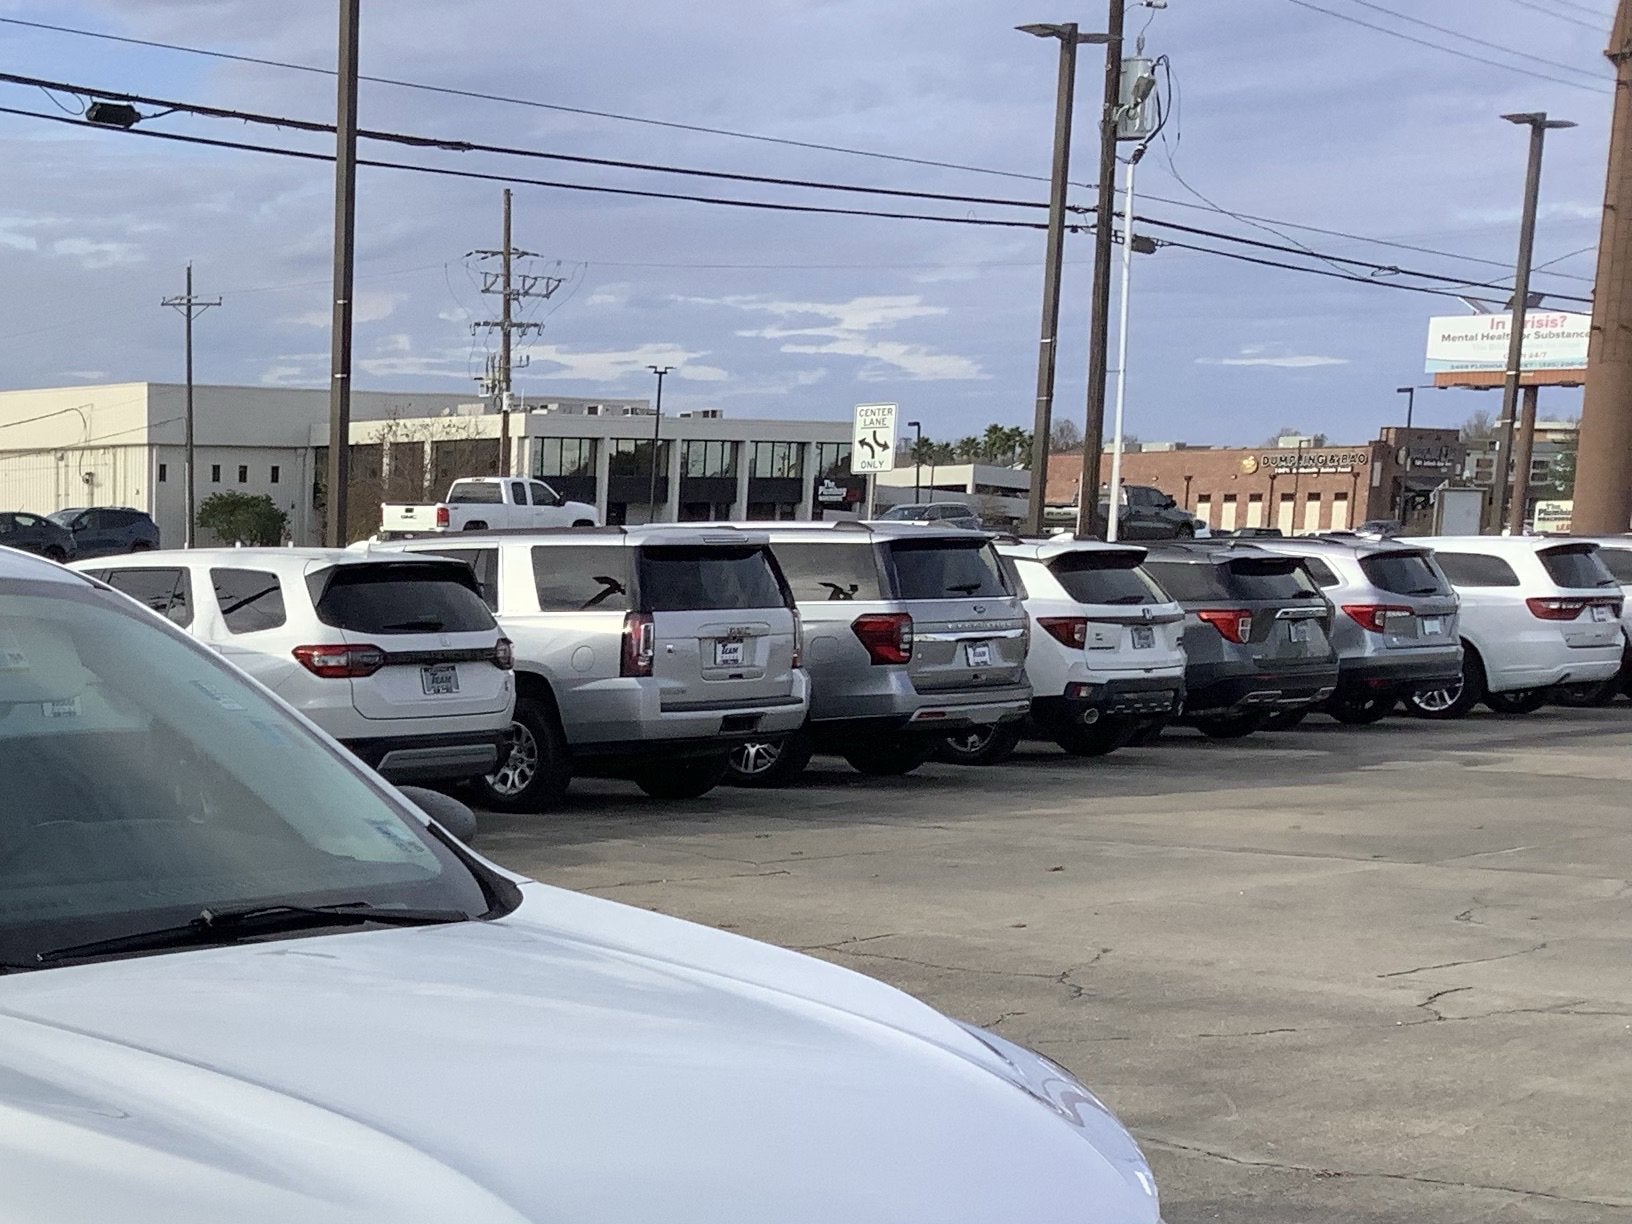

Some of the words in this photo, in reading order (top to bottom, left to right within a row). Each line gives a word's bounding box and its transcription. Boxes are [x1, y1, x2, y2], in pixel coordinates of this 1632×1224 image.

[1490, 318, 1505, 330] In
[1524, 315, 1567, 329] risis?
[1441, 333, 1478, 342] Mental
[1481, 332, 1511, 341] Healt
[858, 407, 894, 417] CENTER
[863, 417, 887, 427] LANE
[1341, 452, 1367, 465] BAO
[860, 460, 885, 469] ONLY
